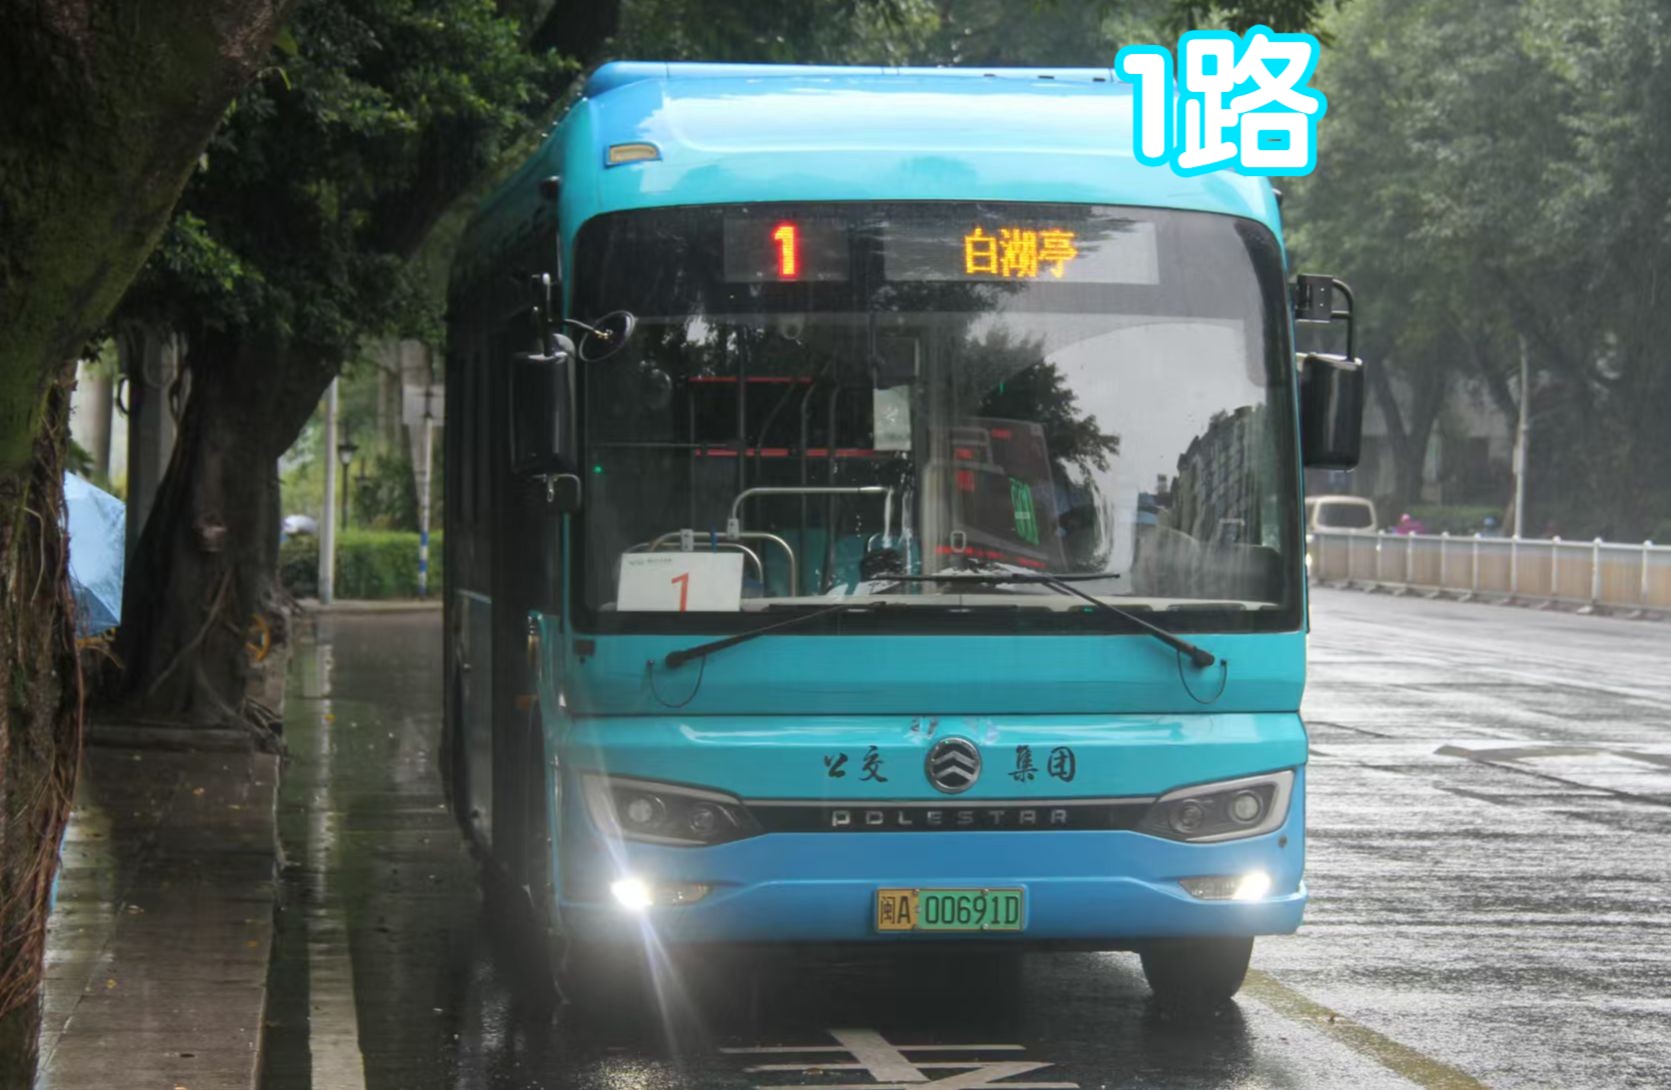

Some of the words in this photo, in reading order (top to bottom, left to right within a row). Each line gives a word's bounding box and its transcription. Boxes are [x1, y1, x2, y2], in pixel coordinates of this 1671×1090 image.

[773, 223, 797, 278] 1
[963, 227, 1078, 278] 白湖亭
[671, 571, 689, 612] 1
[823, 745, 888, 783] 公交
[1008, 745, 1077, 783] 集团
[832, 809, 1068, 826] POLESTAR
